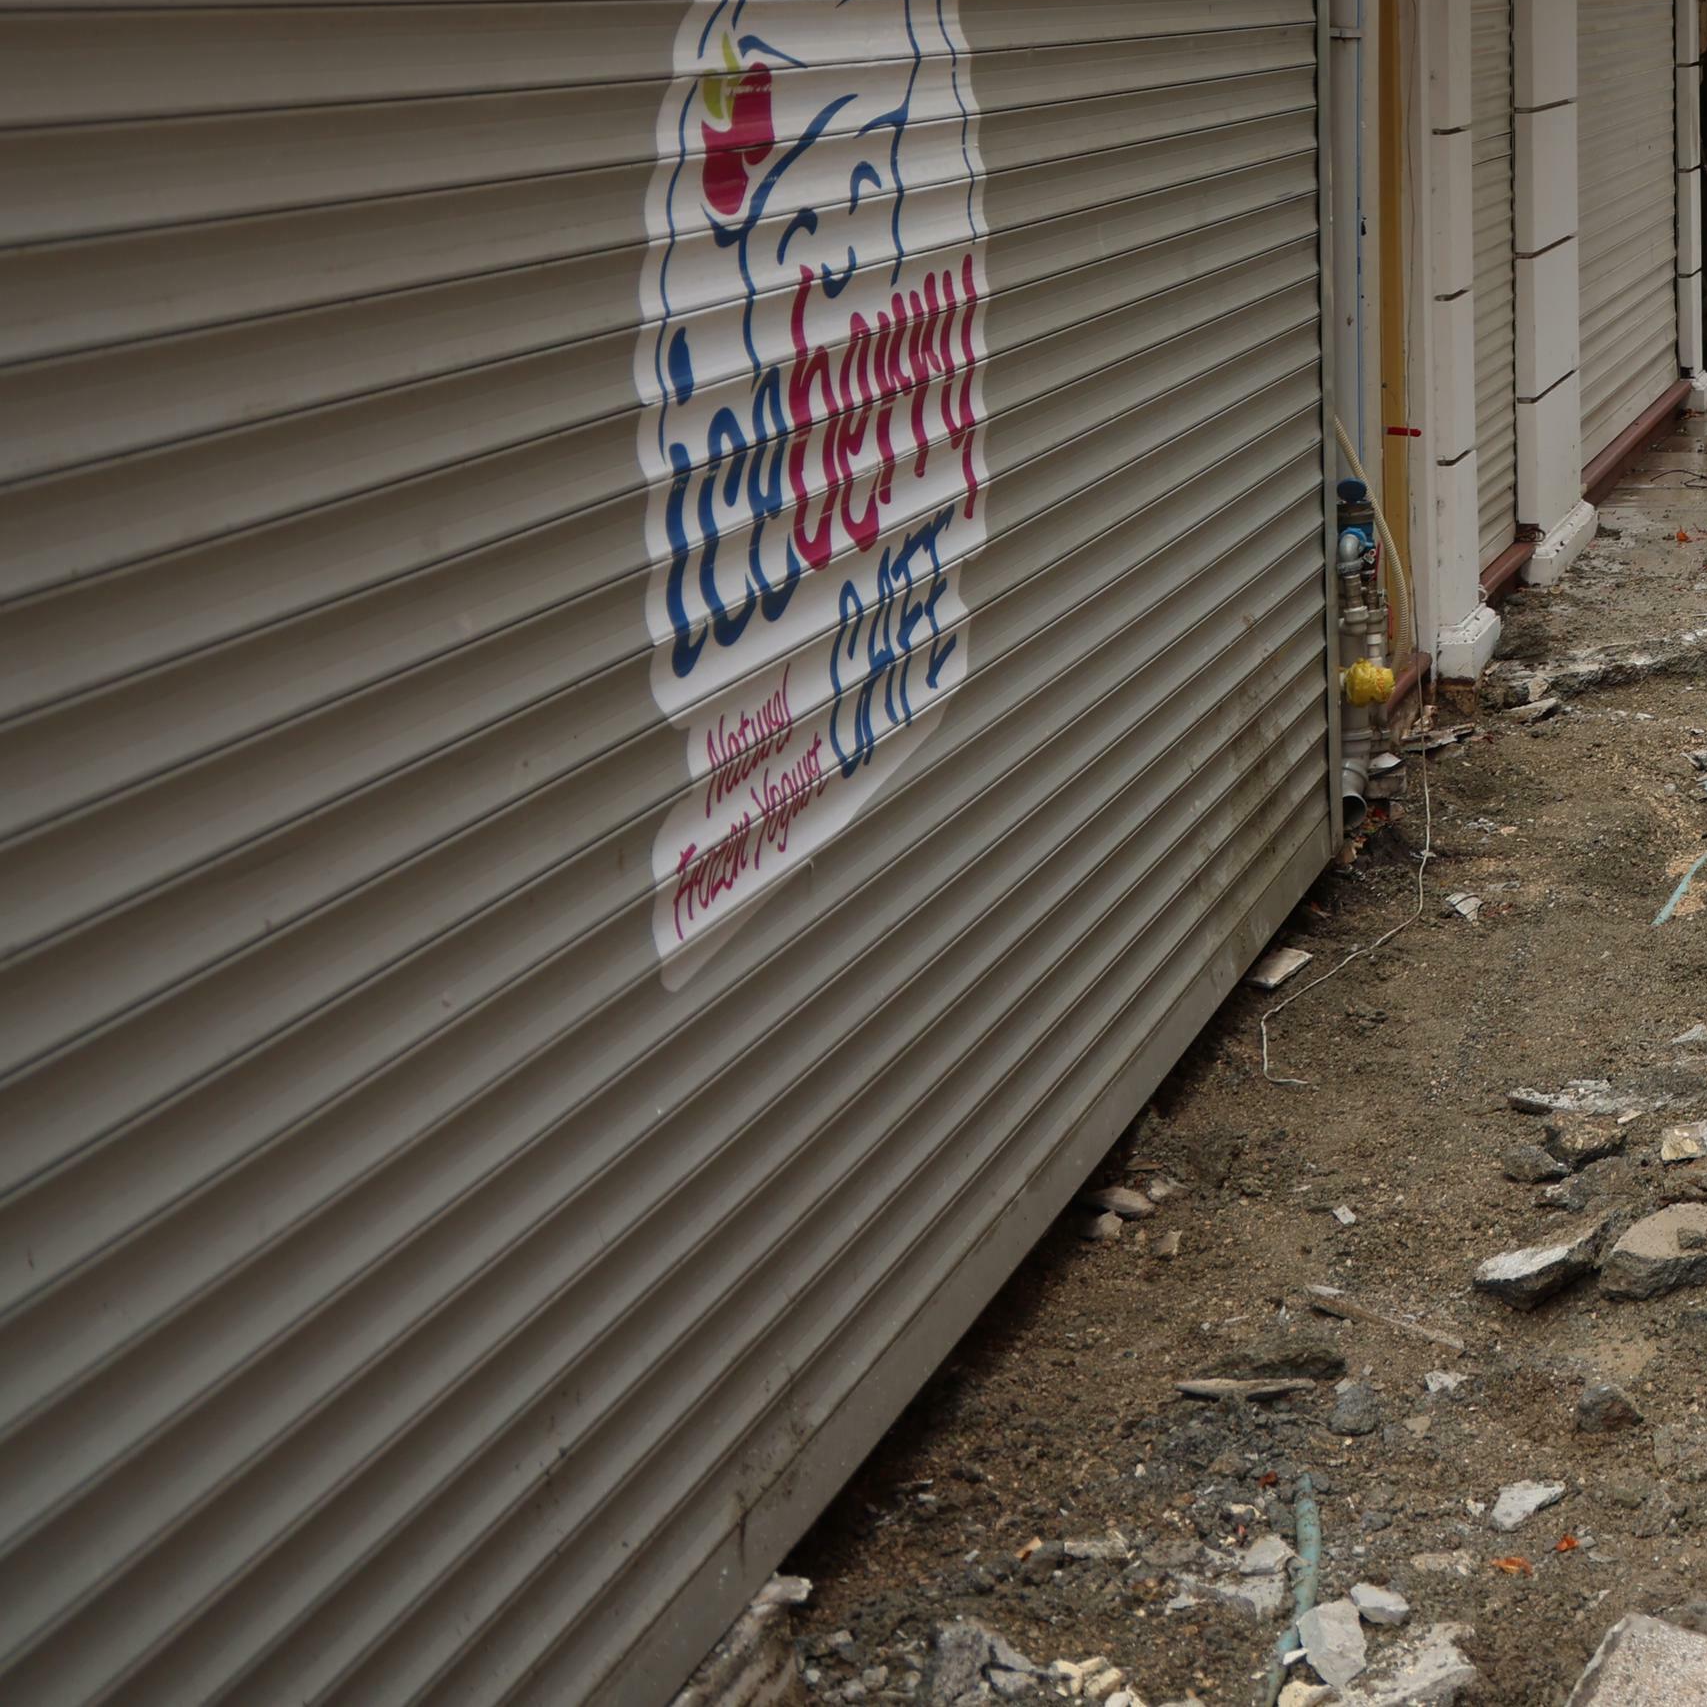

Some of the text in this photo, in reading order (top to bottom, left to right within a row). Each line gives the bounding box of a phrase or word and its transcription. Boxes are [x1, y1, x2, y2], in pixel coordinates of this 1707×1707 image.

[704, 662, 793, 820] Natural
[829, 503, 957, 781] CAFE
[672, 731, 830, 942] Frozen Yogurt
